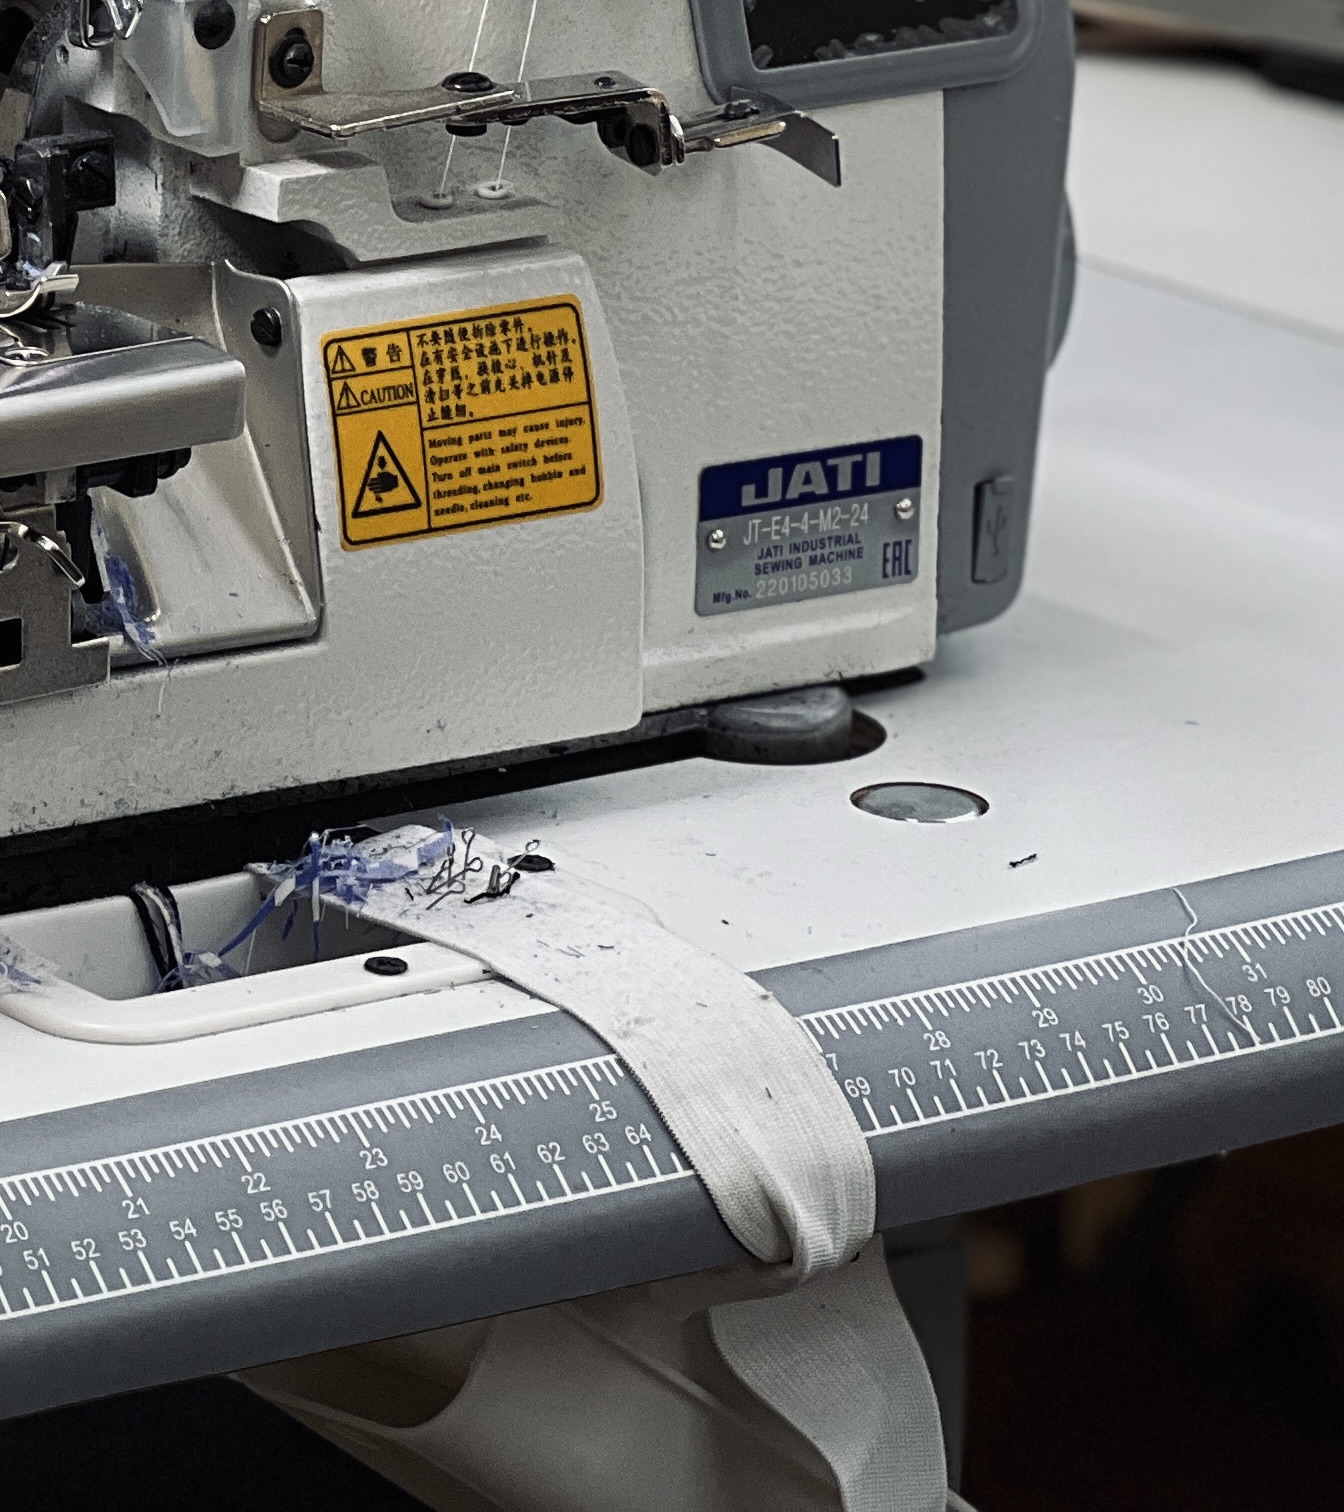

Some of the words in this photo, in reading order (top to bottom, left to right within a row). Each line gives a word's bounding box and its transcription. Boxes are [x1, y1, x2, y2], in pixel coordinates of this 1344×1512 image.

[361, 343, 402, 368] 警告
[360, 382, 415, 405] CAUTION
[428, 435, 462, 448] Moving
[468, 431, 492, 444] parts
[498, 427, 517, 438] may
[523, 422, 549, 433] cause
[430, 453, 467, 467] Operate
[473, 447, 495, 458] with
[501, 442, 528, 455] safety
[431, 471, 453, 482] Turn
[459, 466, 472, 478] off
[477, 464, 501, 475] main
[507, 456, 537, 470] switch
[543, 452, 572, 464] before
[483, 477, 525, 492] changing
[569, 464, 586, 476] and
[741, 451, 881, 507] JATI
[470, 496, 510, 510] cleaning
[744, 502, 869, 546] JT-E4-4-M2-24
[757, 545, 783, 560] JATI
[789, 532, 861, 554] INDUSTRIAL
[754, 556, 803, 576] SEWING
[809, 546, 864, 566] MACHINE
[756, 566, 853, 599] 220105033
[0, 1222, 28, 1243] 20
[122, 1198, 149, 1218] 21
[241, 1173, 270, 1194] 22
[360, 1148, 388, 1169] 23
[475, 1124, 501, 1145] 24
[589, 1101, 617, 1122] 25
[825, 1053, 839, 1072] 7
[923, 1031, 950, 1050] 28
[1032, 1008, 1058, 1027] 29
[1137, 985, 1163, 1004] 30
[1242, 963, 1267, 981] 31
[23, 1248, 49, 1269] 51
[71, 1238, 100, 1260] 52
[119, 1229, 146, 1250] 53
[170, 1218, 196, 1239] 54
[215, 1209, 243, 1230] 55
[260, 1199, 287, 1221] 56
[308, 1189, 331, 1211] 57
[352, 1181, 379, 1201] 58
[397, 1171, 423, 1192] 59
[443, 1161, 470, 1183] 60
[490, 1152, 515, 1173] 61
[537, 1142, 565, 1163] 62
[583, 1133, 609, 1153] 63
[625, 1124, 651, 1144] 64
[845, 1077, 870, 1097] 69
[888, 1067, 915, 1087] 70
[930, 1059, 956, 1078] 71
[974, 1049, 1003, 1069] 72
[1018, 1039, 1045, 1059] 73
[1060, 1031, 1086, 1050] 74
[1102, 1021, 1129, 1042] 75
[1142, 1013, 1169, 1032] 76
[1184, 1004, 1207, 1023] 77
[1226, 995, 1252, 1014] 78
[1264, 986, 1290, 1006] 79
[1306, 977, 1331, 997] 80
